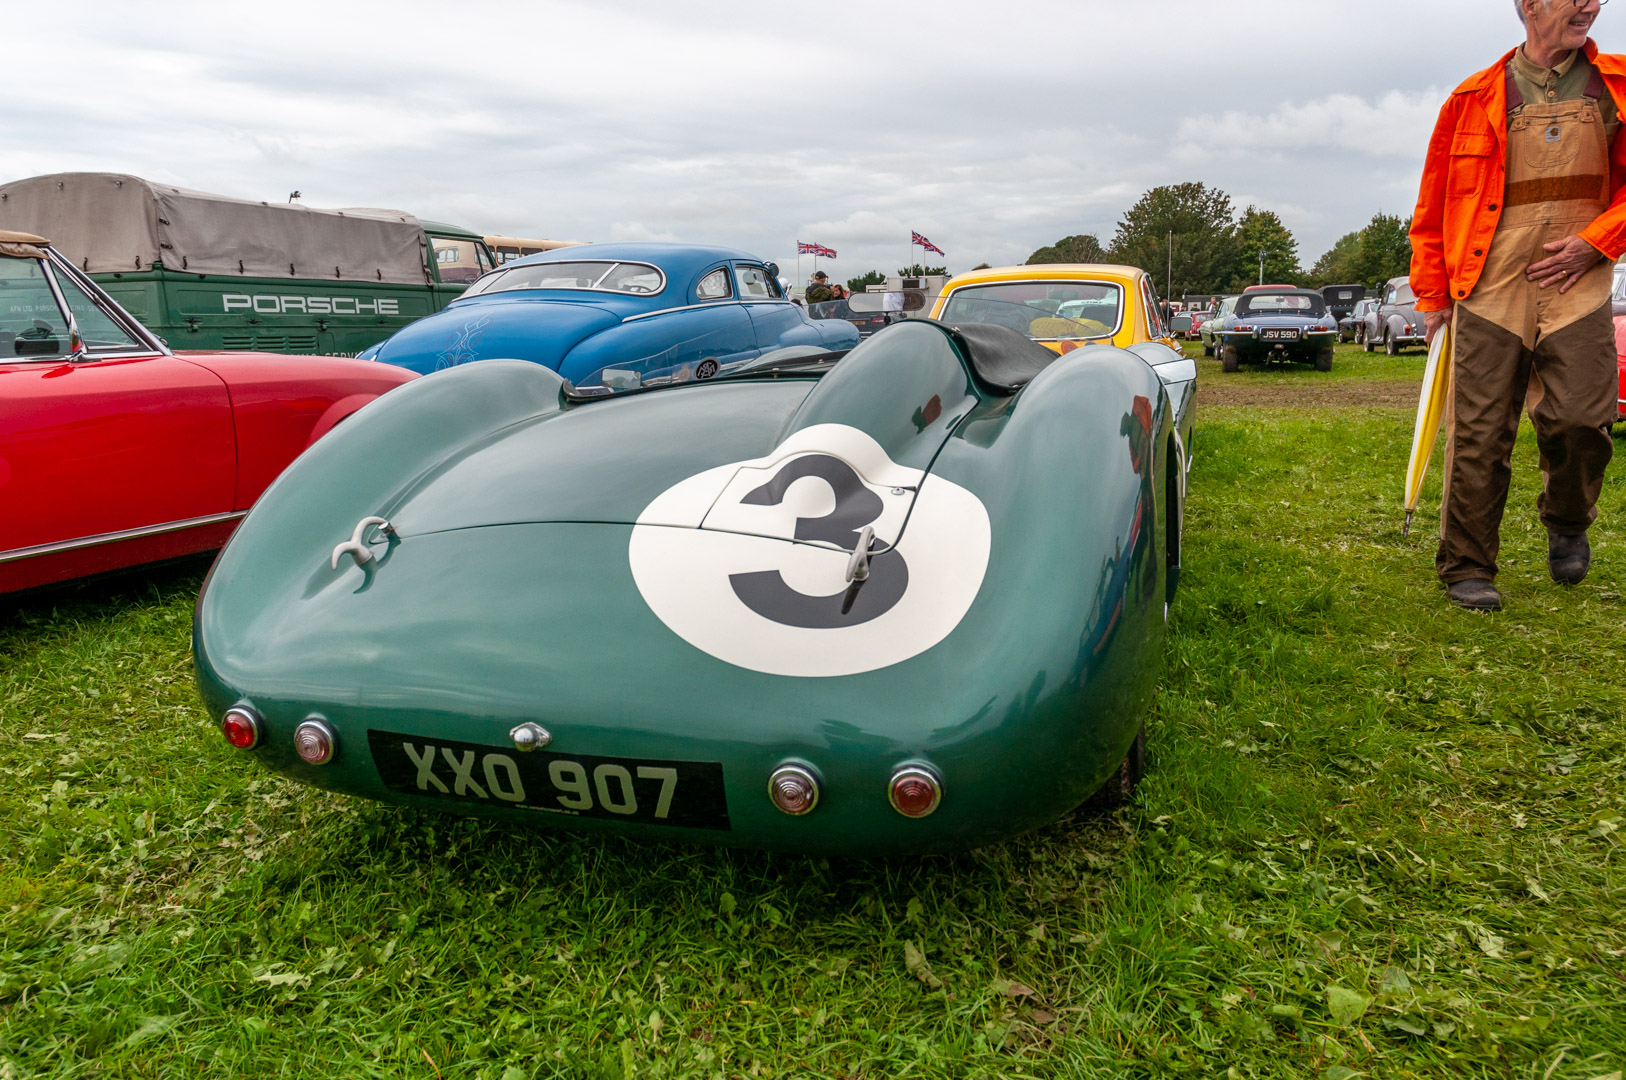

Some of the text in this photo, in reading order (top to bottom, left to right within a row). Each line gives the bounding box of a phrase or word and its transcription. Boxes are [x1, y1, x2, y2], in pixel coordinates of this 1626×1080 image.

[222, 294, 399, 314] PORSCHE
[728, 453, 909, 628] 3
[403, 741, 678, 819] XXO 907
